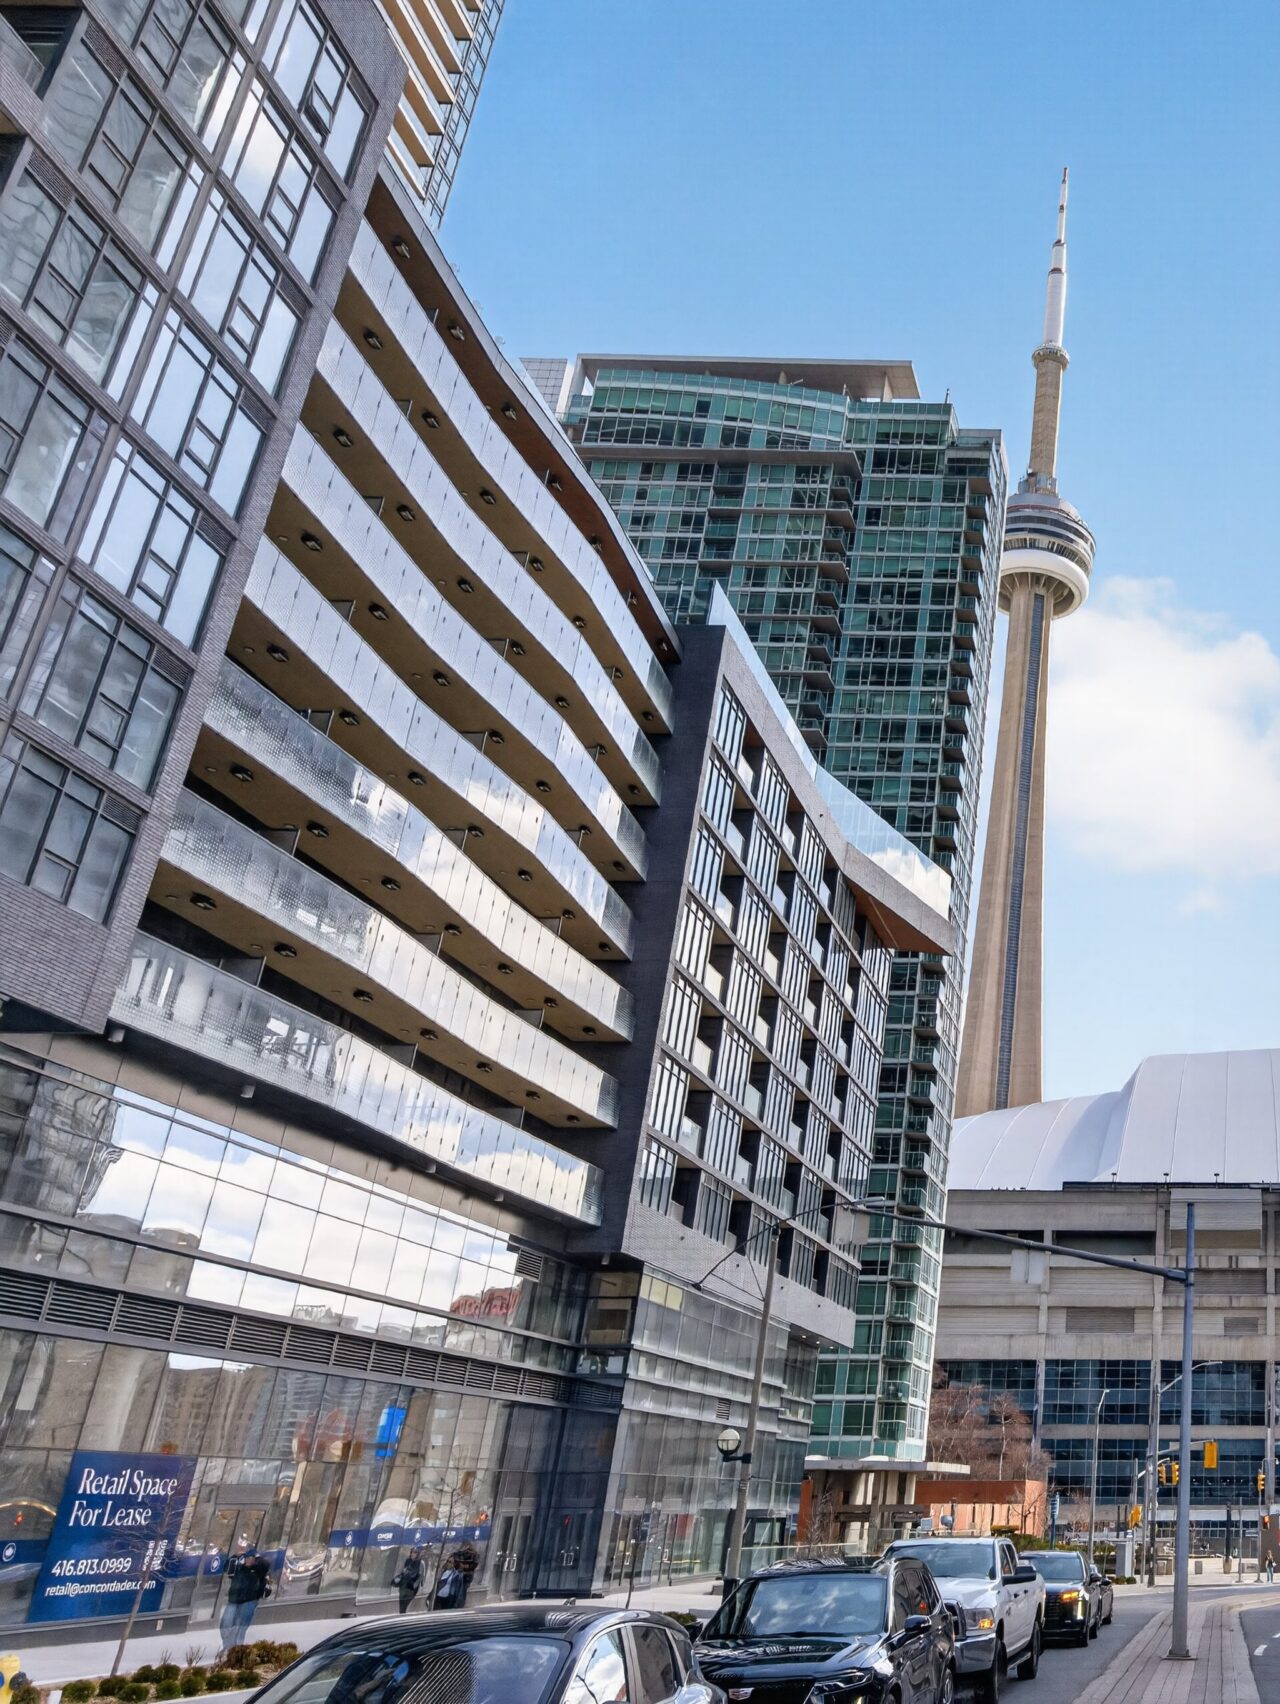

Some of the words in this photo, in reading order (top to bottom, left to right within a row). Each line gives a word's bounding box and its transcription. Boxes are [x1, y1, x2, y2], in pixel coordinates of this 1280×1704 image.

[77, 1467, 131, 1496] Retail
[129, 1469, 178, 1502] Space
[68, 1500, 103, 1527] For
[102, 1500, 152, 1527] Lease
[51, 1557, 132, 1577] 416.813.0999
